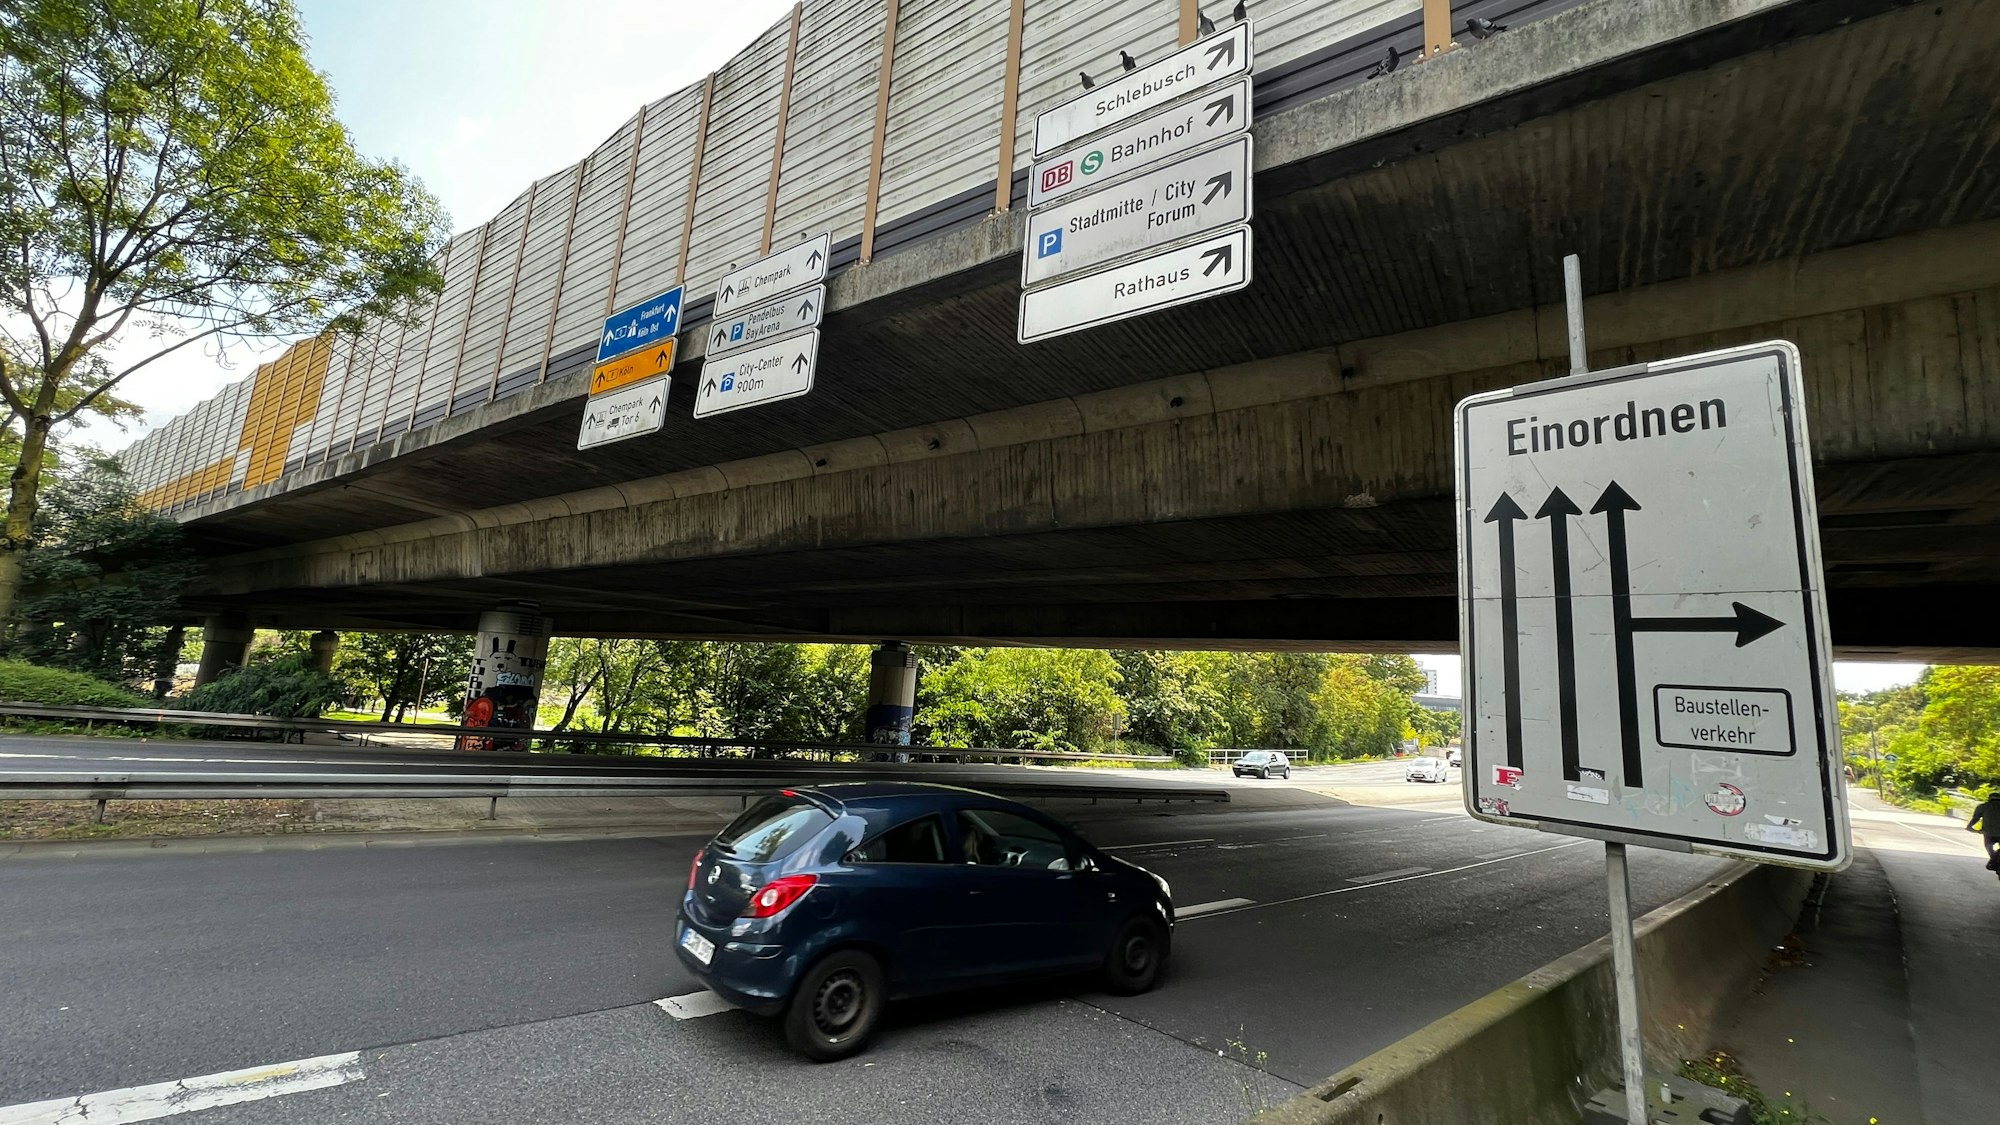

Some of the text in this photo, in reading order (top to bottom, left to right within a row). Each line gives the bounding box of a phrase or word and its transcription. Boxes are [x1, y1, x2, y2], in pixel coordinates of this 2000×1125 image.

[1095, 64, 1196, 116] Schlebusch
[1044, 164, 1071, 190] DB
[1111, 117, 1194, 163] Bahnhof
[1070, 197, 1144, 234] Stadtmitte
[1165, 178, 1196, 202] City
[1147, 202, 1196, 230] Forum
[1042, 233, 1058, 255] P
[754, 264, 791, 288] Chempark
[1114, 266, 1190, 299] Rathaus
[641, 304, 664, 320] Frankfurt
[748, 304, 785, 325] Pendelbus
[733, 324, 742, 339] P
[739, 355, 784, 377] City-Center
[737, 379, 764, 394] 900m
[609, 396, 643, 414] Chempark
[622, 411, 640, 426] Tor 6
[1507, 397, 1727, 456] Einordnen
[1675, 695, 1769, 719] Baustellen-
[1691, 726, 1756, 745] verkehr
